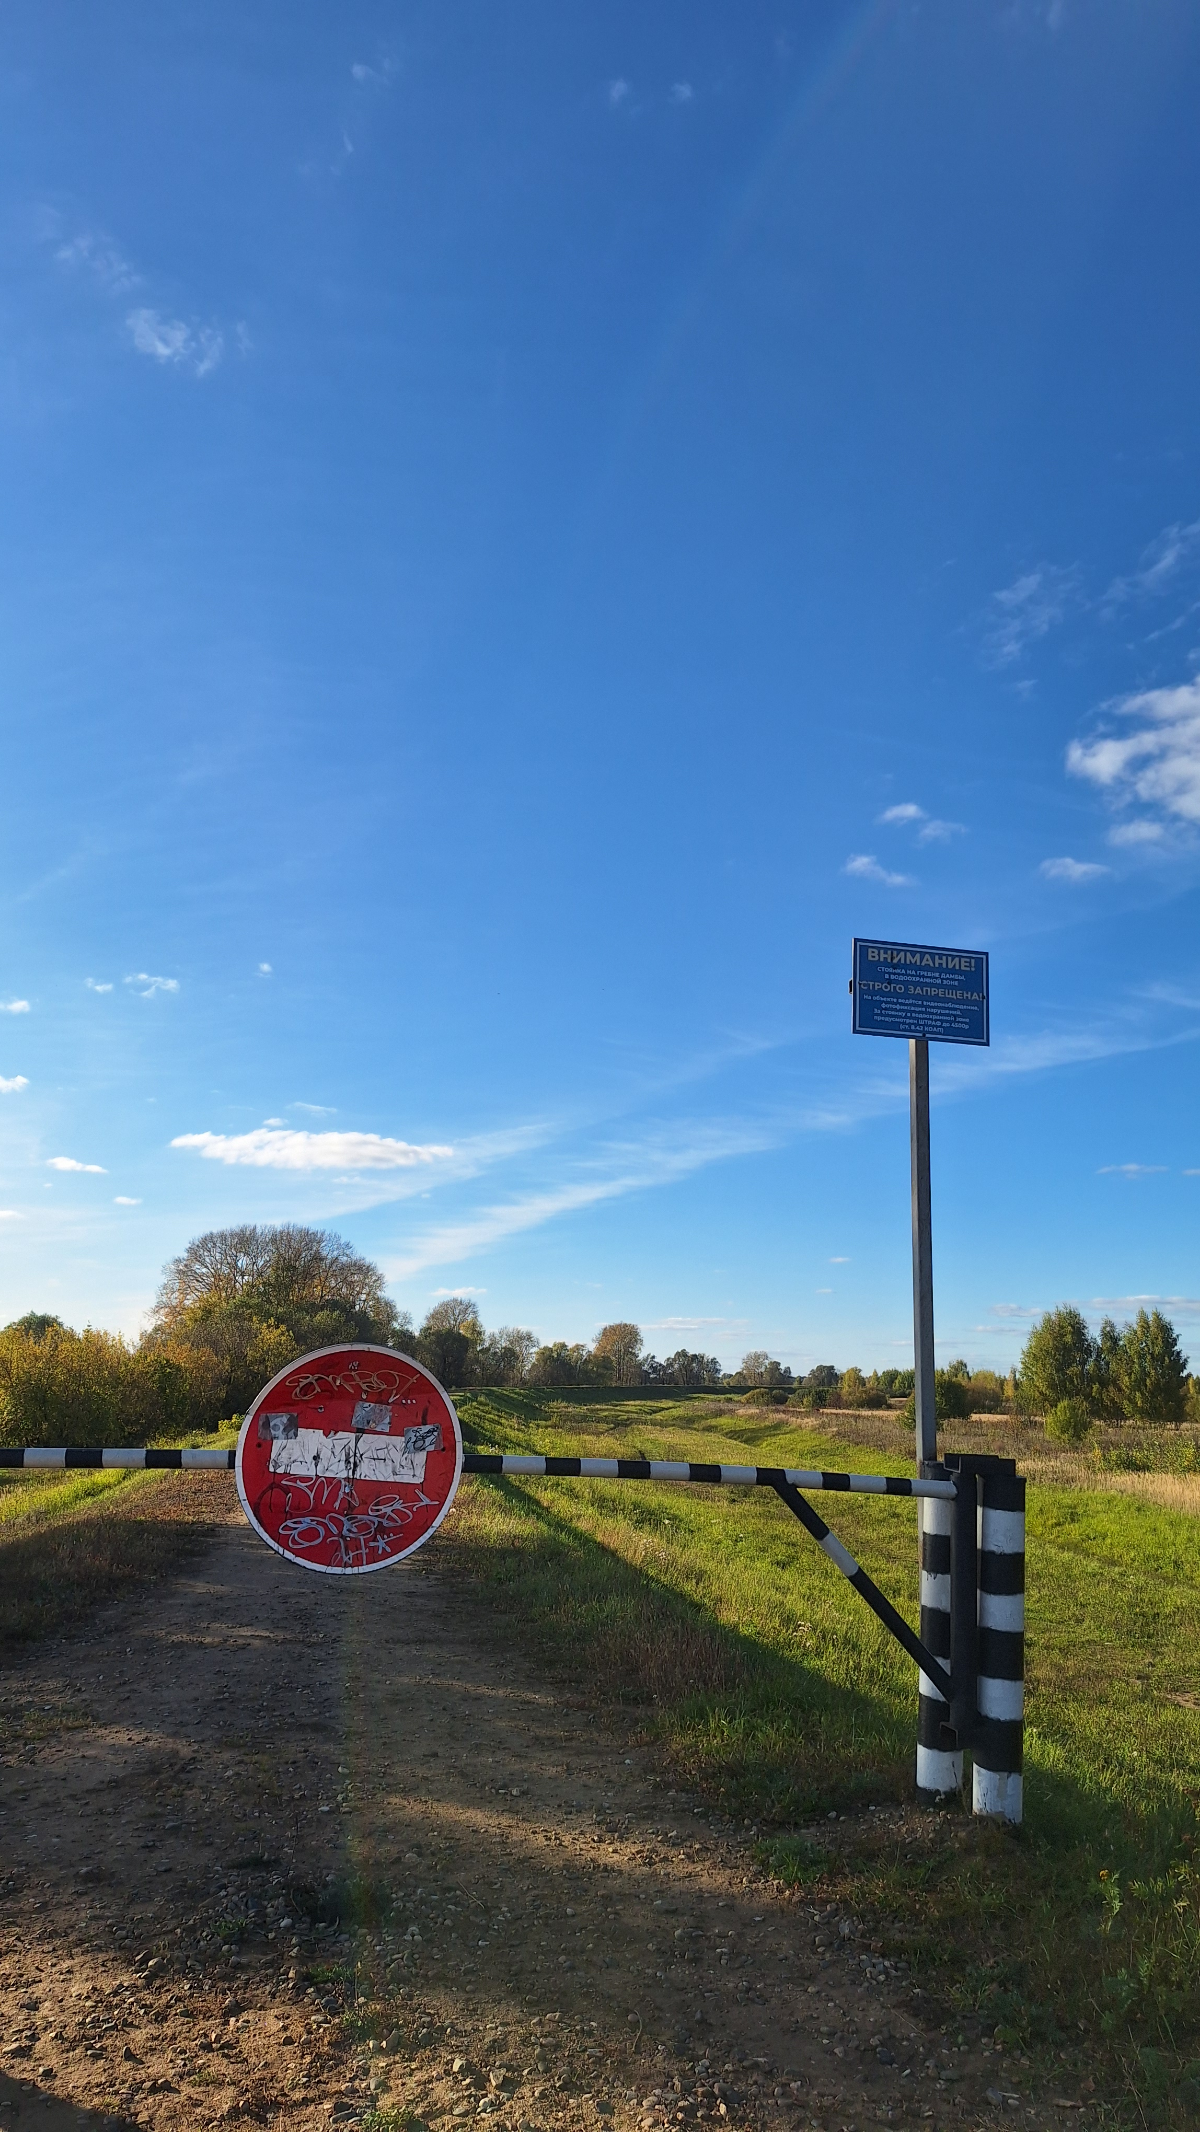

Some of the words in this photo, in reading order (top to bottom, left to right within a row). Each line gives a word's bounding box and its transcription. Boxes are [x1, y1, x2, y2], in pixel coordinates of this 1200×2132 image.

[868, 948, 975, 971] ВНИМАНИЕ!
[891, 975, 941, 984] ВОДООХРАННОЙ
[861, 981, 904, 993] СТРОГО
[908, 987, 983, 1000] ЗАПРЕЩЕНА!
[881, 1003, 925, 1012] фотофиксация
[874, 1015, 917, 1024] предусмотрен
[912, 1013, 954, 1022] водоохранной
